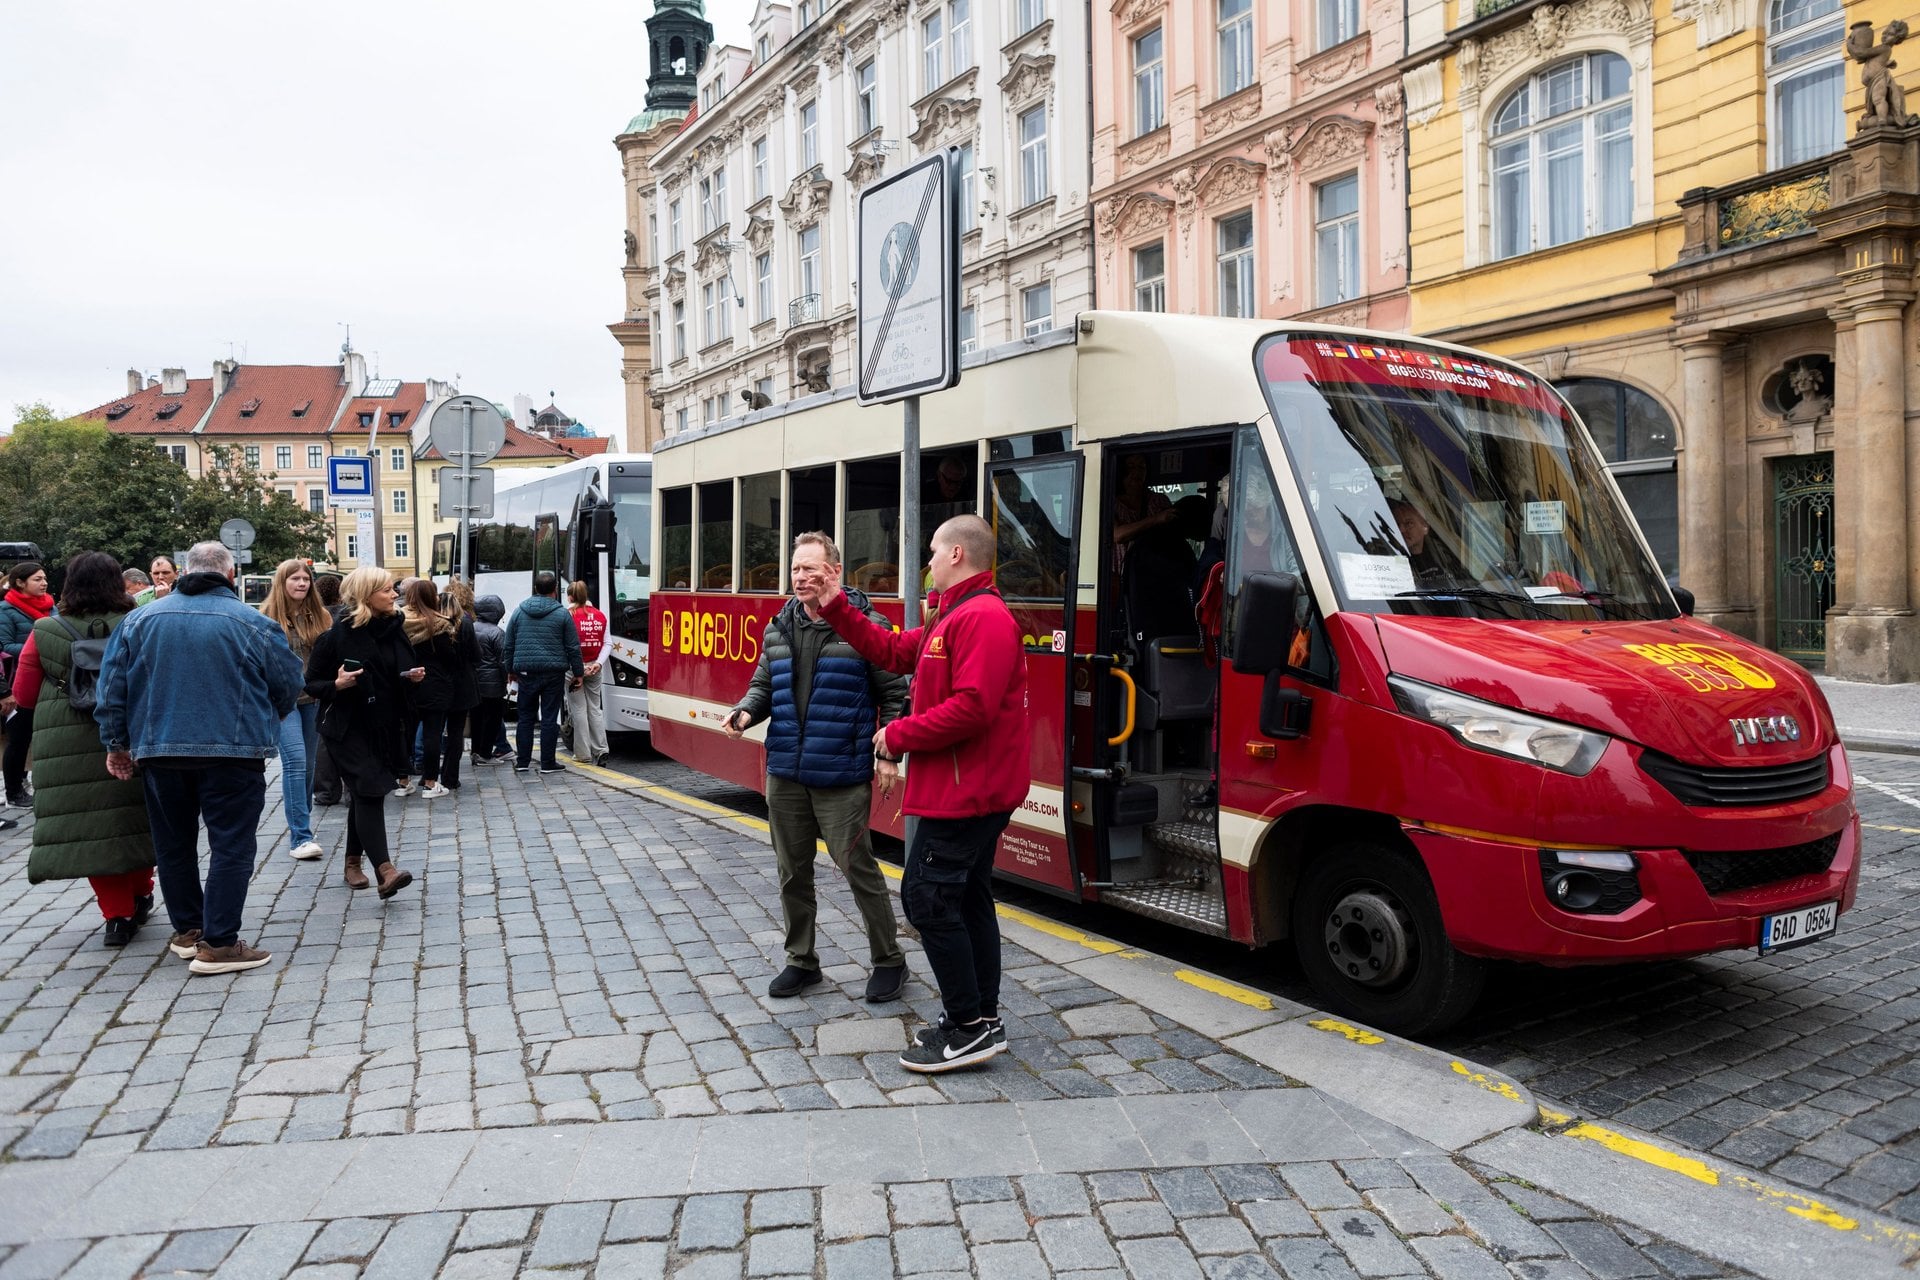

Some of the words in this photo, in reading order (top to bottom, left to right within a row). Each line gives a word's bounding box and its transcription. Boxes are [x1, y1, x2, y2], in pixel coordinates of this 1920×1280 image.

[1387, 364, 1490, 389] BIGBUSTOURS.COM
[1622, 643, 1705, 666] BIG
[1667, 664, 1745, 693] BUS
[1729, 716, 1800, 745] IVECO
[1020, 838, 1028, 849] City
[1773, 916, 1797, 941] 6AD
[1805, 906, 1831, 934] 0584
